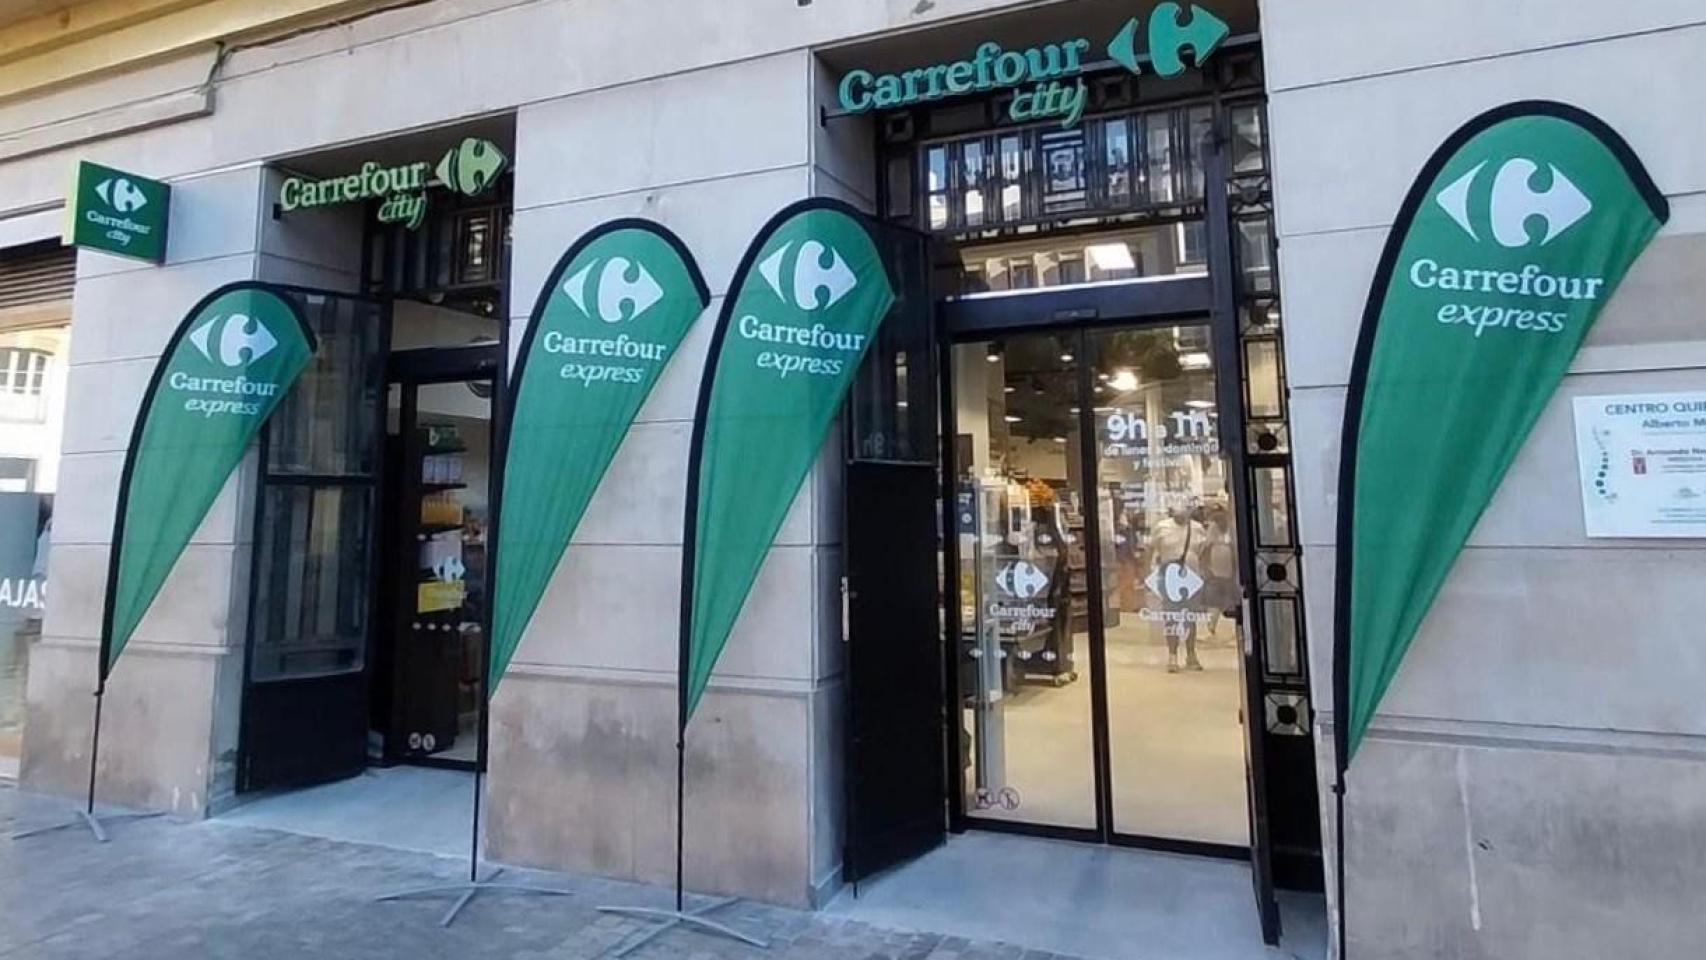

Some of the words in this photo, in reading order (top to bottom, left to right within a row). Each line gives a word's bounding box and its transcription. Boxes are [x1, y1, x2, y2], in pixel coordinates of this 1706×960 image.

[839, 38, 1089, 113] Carrefour
[1009, 77, 1087, 129] city
[281, 162, 429, 211] Carrefour
[86, 210, 151, 235] Carrefour
[378, 193, 428, 231] city
[106, 229, 131, 245] city
[1410, 258, 1604, 300] Carrefour
[739, 315, 865, 351] Carrefour
[1437, 303, 1567, 337] express
[543, 331, 667, 361] Carrefour
[560, 362, 643, 388] express
[757, 350, 843, 378] express
[170, 372, 279, 397] Carrefour
[185, 399, 259, 418] express
[1605, 403, 1668, 416] CENTRO
[1106, 412, 1147, 441] 9h
[989, 604, 1056, 619] Carrefour
[1138, 607, 1213, 622] Carrefour
